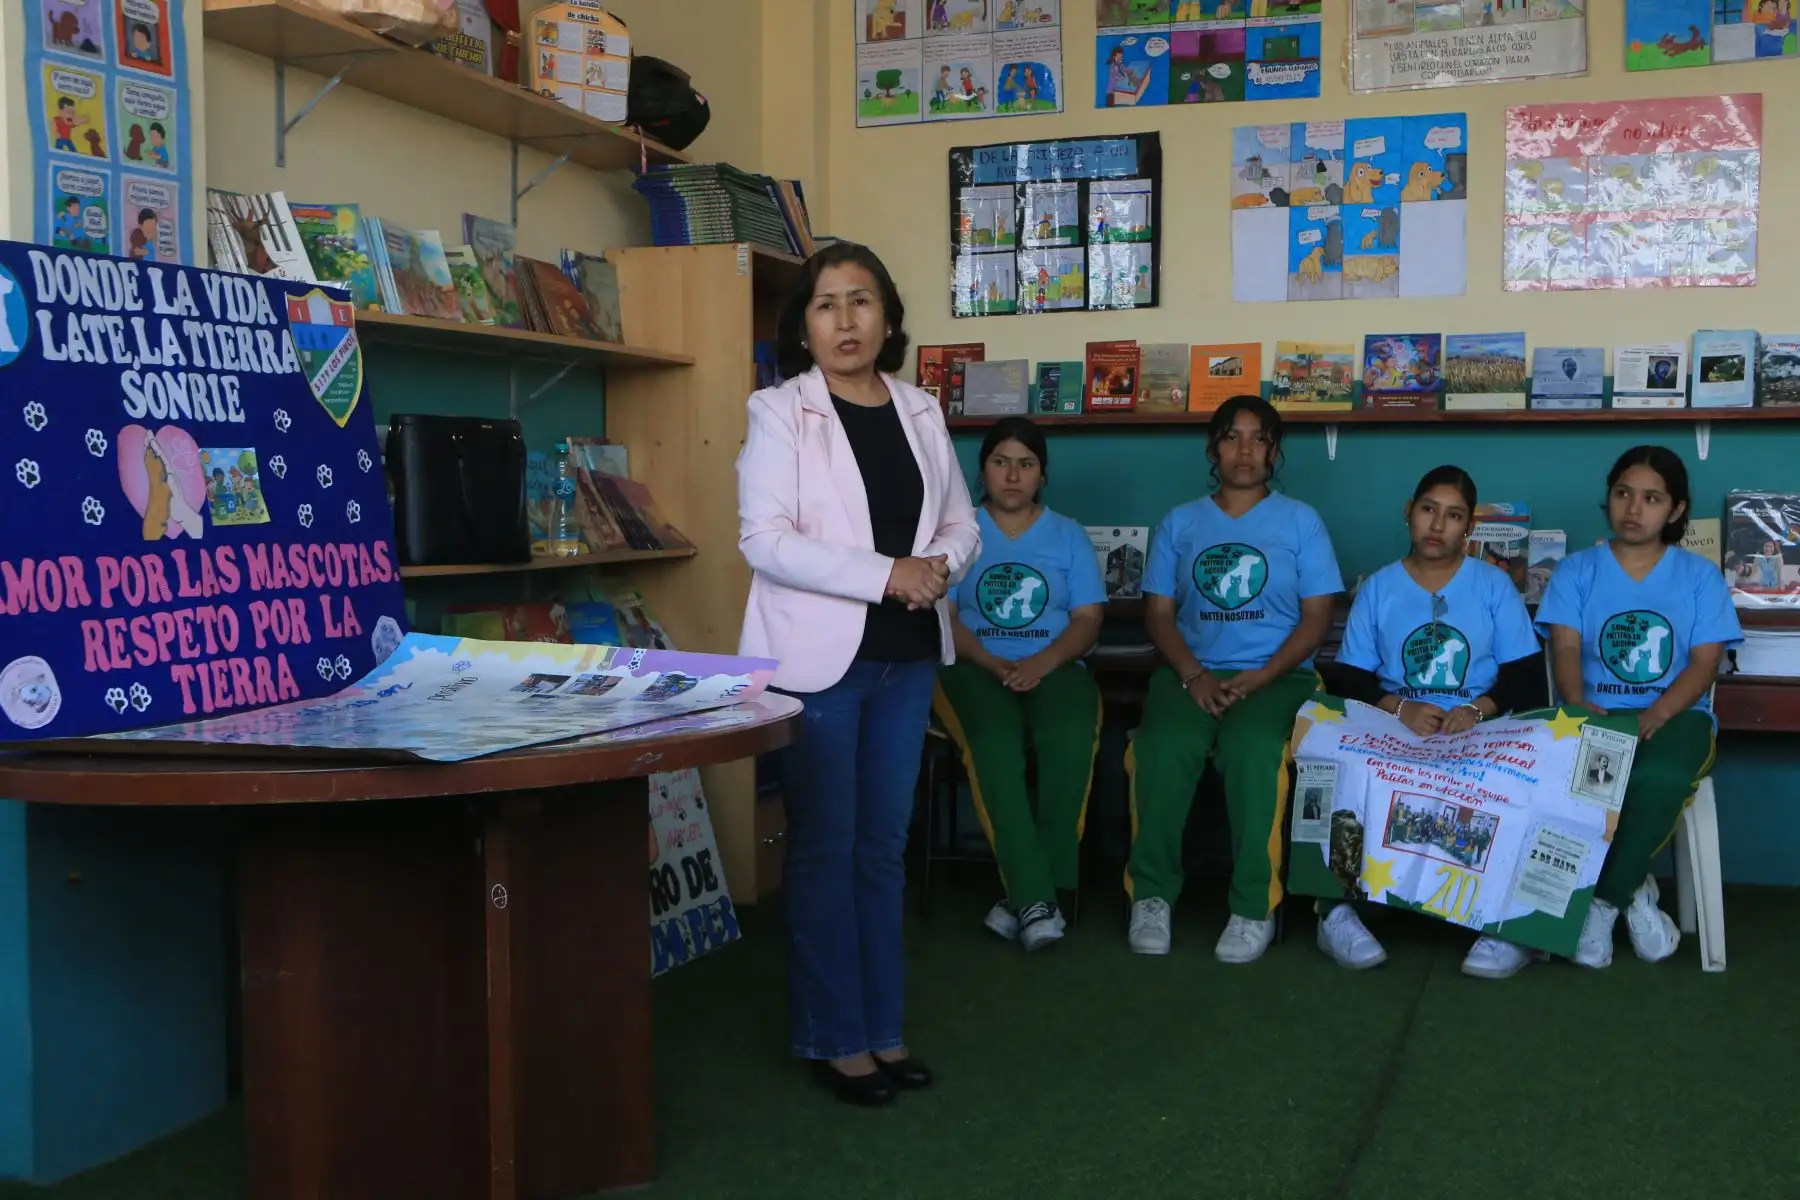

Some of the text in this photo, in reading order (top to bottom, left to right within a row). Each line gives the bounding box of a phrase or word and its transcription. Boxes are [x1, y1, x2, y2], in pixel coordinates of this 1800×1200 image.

[980, 150, 998, 164] DE
[1624, 127, 1642, 140] no
[28, 250, 278, 325] DONDE LA VIDA
[338, 308, 348, 322] E
[182, 321, 302, 374] TIERRA
[328, 354, 342, 376] LOS
[338, 333, 356, 360] PINOS
[120, 369, 246, 423] SONRIE
[95, 554, 173, 609] POR
[171, 548, 242, 600] LAS
[243, 540, 400, 592] MASCOTAS.
[81, 594, 363, 672] RESPETO POR LA
[170, 652, 301, 714] TIERRA
[1366, 758, 1383, 766] Con
[1466, 782, 1474, 791] el
[680, 848, 719, 900] DE
[1530, 849, 1538, 860] 2
[1539, 852, 1552, 864] DE
[1422, 862, 1482, 924] 200
